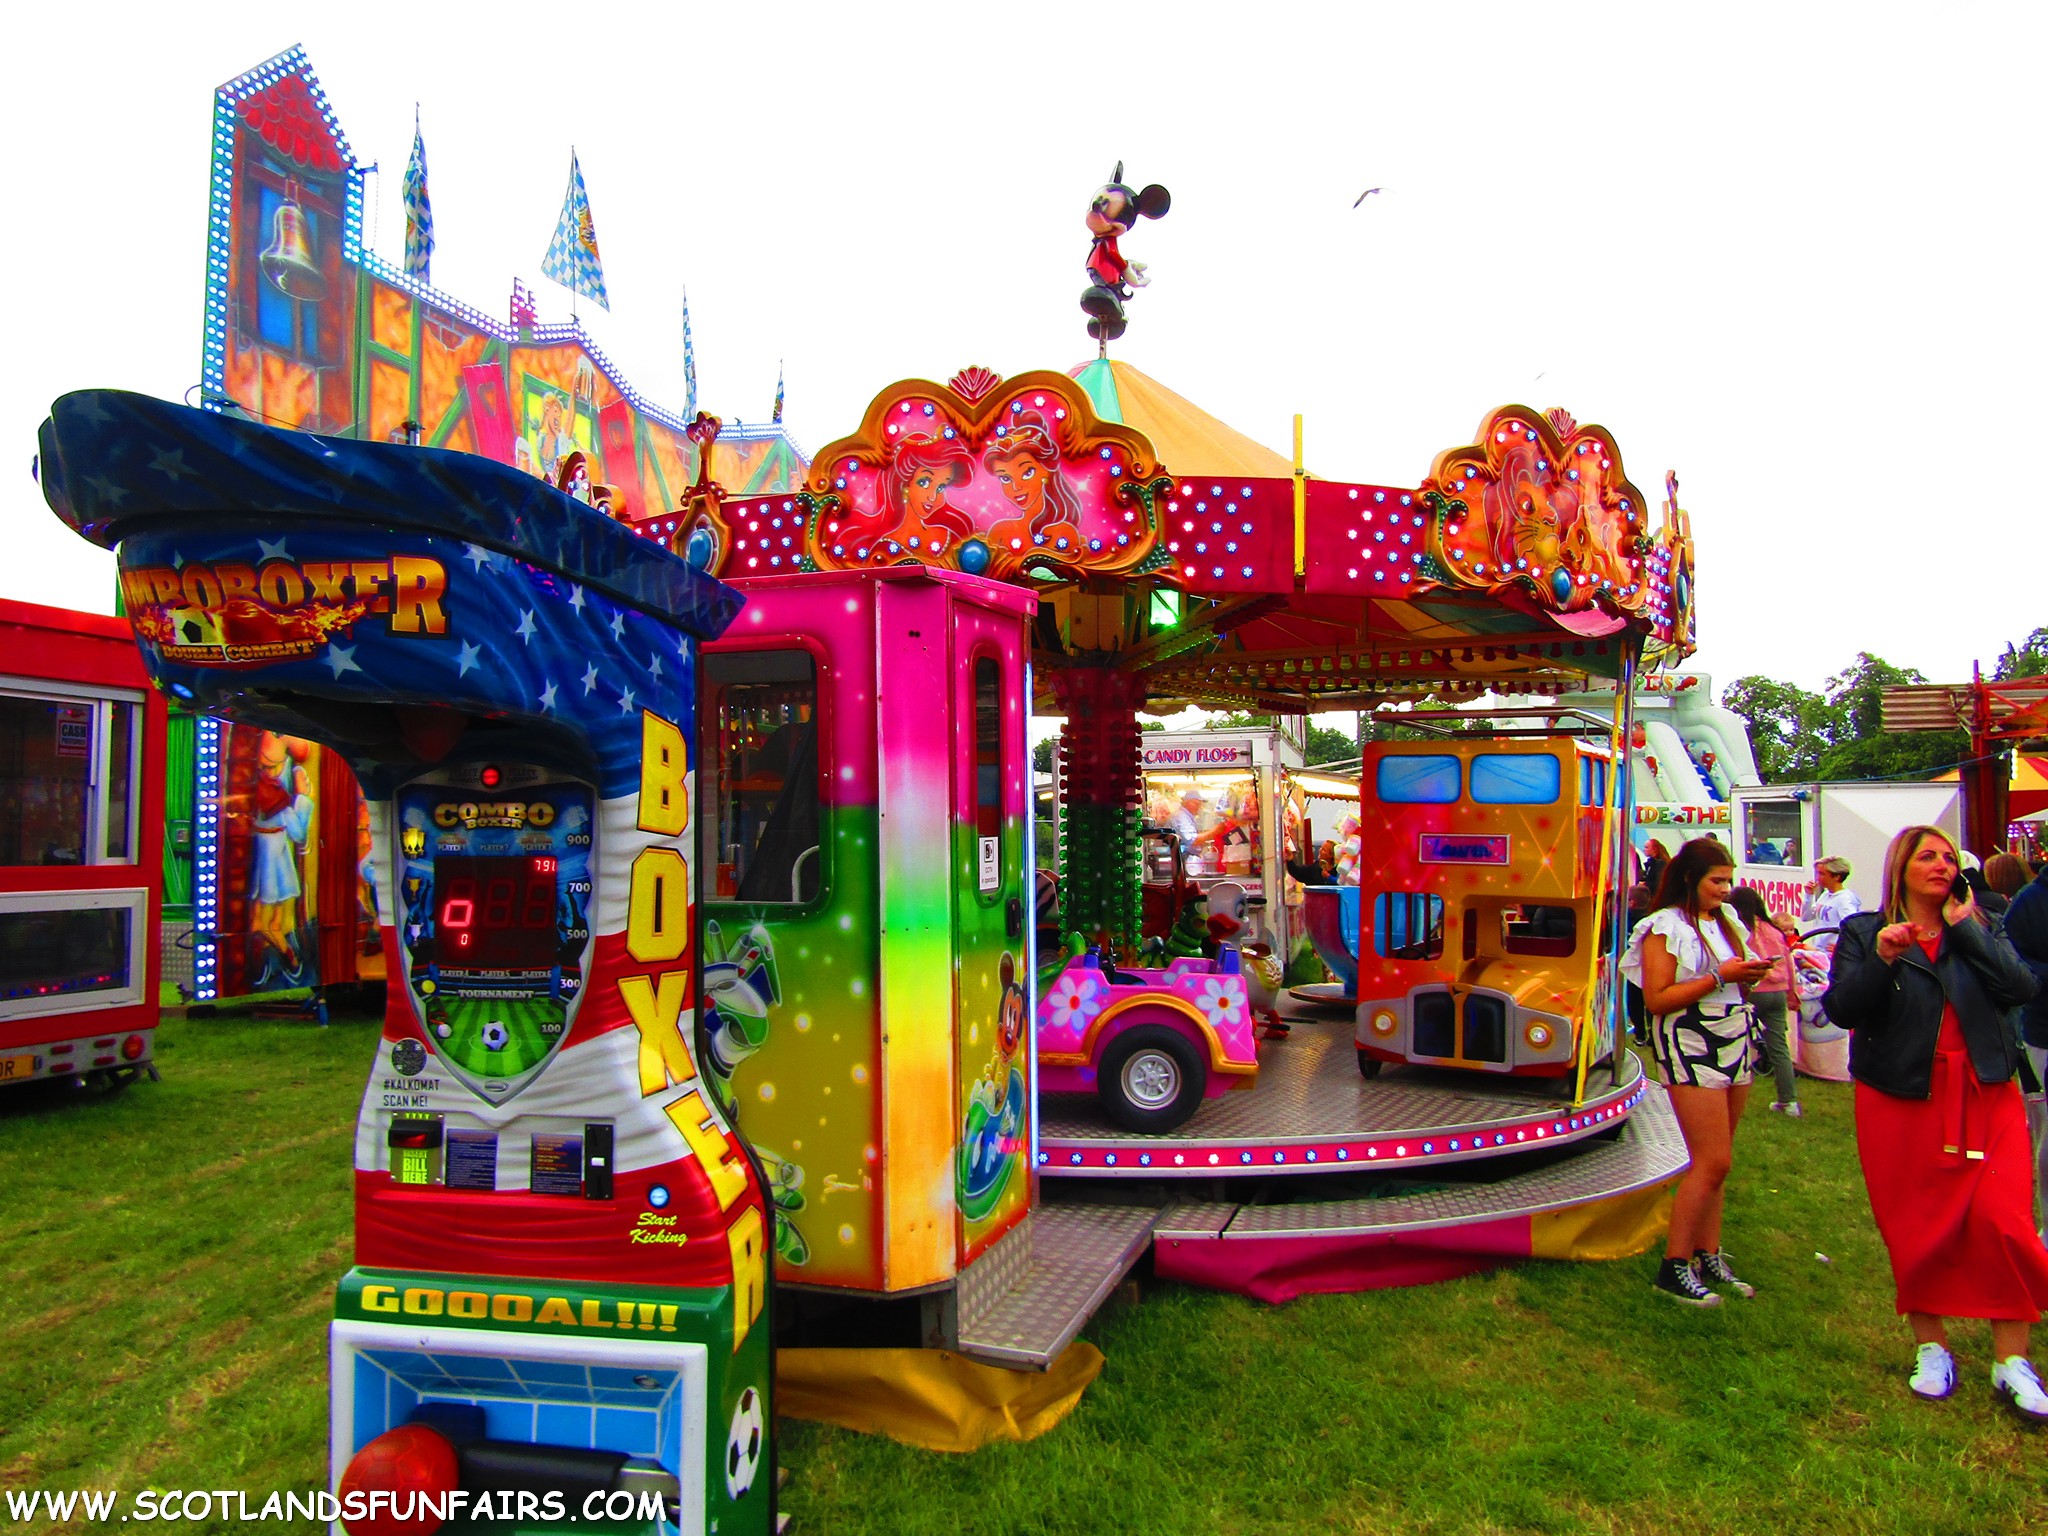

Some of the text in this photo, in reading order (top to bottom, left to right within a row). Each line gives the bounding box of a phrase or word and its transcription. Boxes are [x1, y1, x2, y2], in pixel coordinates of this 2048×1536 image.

[162, 639, 316, 661] DOUBLE COMBAT
[1144, 746, 1237, 764] CANDY FLOSS
[434, 801, 555, 828] COMBO
[1635, 805, 1730, 825] IDE THE
[466, 817, 524, 829] BOXER
[567, 835, 590, 845] 900
[535, 860, 556, 871] 791
[569, 882, 590, 893] 700
[1740, 878, 1802, 917] DGEMS
[461, 934, 469, 945] 0
[567, 930, 588, 939] 500
[560, 979, 581, 988] 300
[458, 989, 535, 999] TOURNAMENT
[542, 1023, 561, 1034] 100
[617, 708, 766, 1355] BOXER
[383, 1079, 440, 1091] #KALKOMAT
[383, 1094, 428, 1107] SCAN ME!
[402, 1158, 428, 1172] BILL
[402, 1171, 428, 1184] HERE
[637, 1211, 678, 1226] Start
[629, 1228, 689, 1248] Kicking
[361, 1284, 679, 1332] GOOOAL!!!
